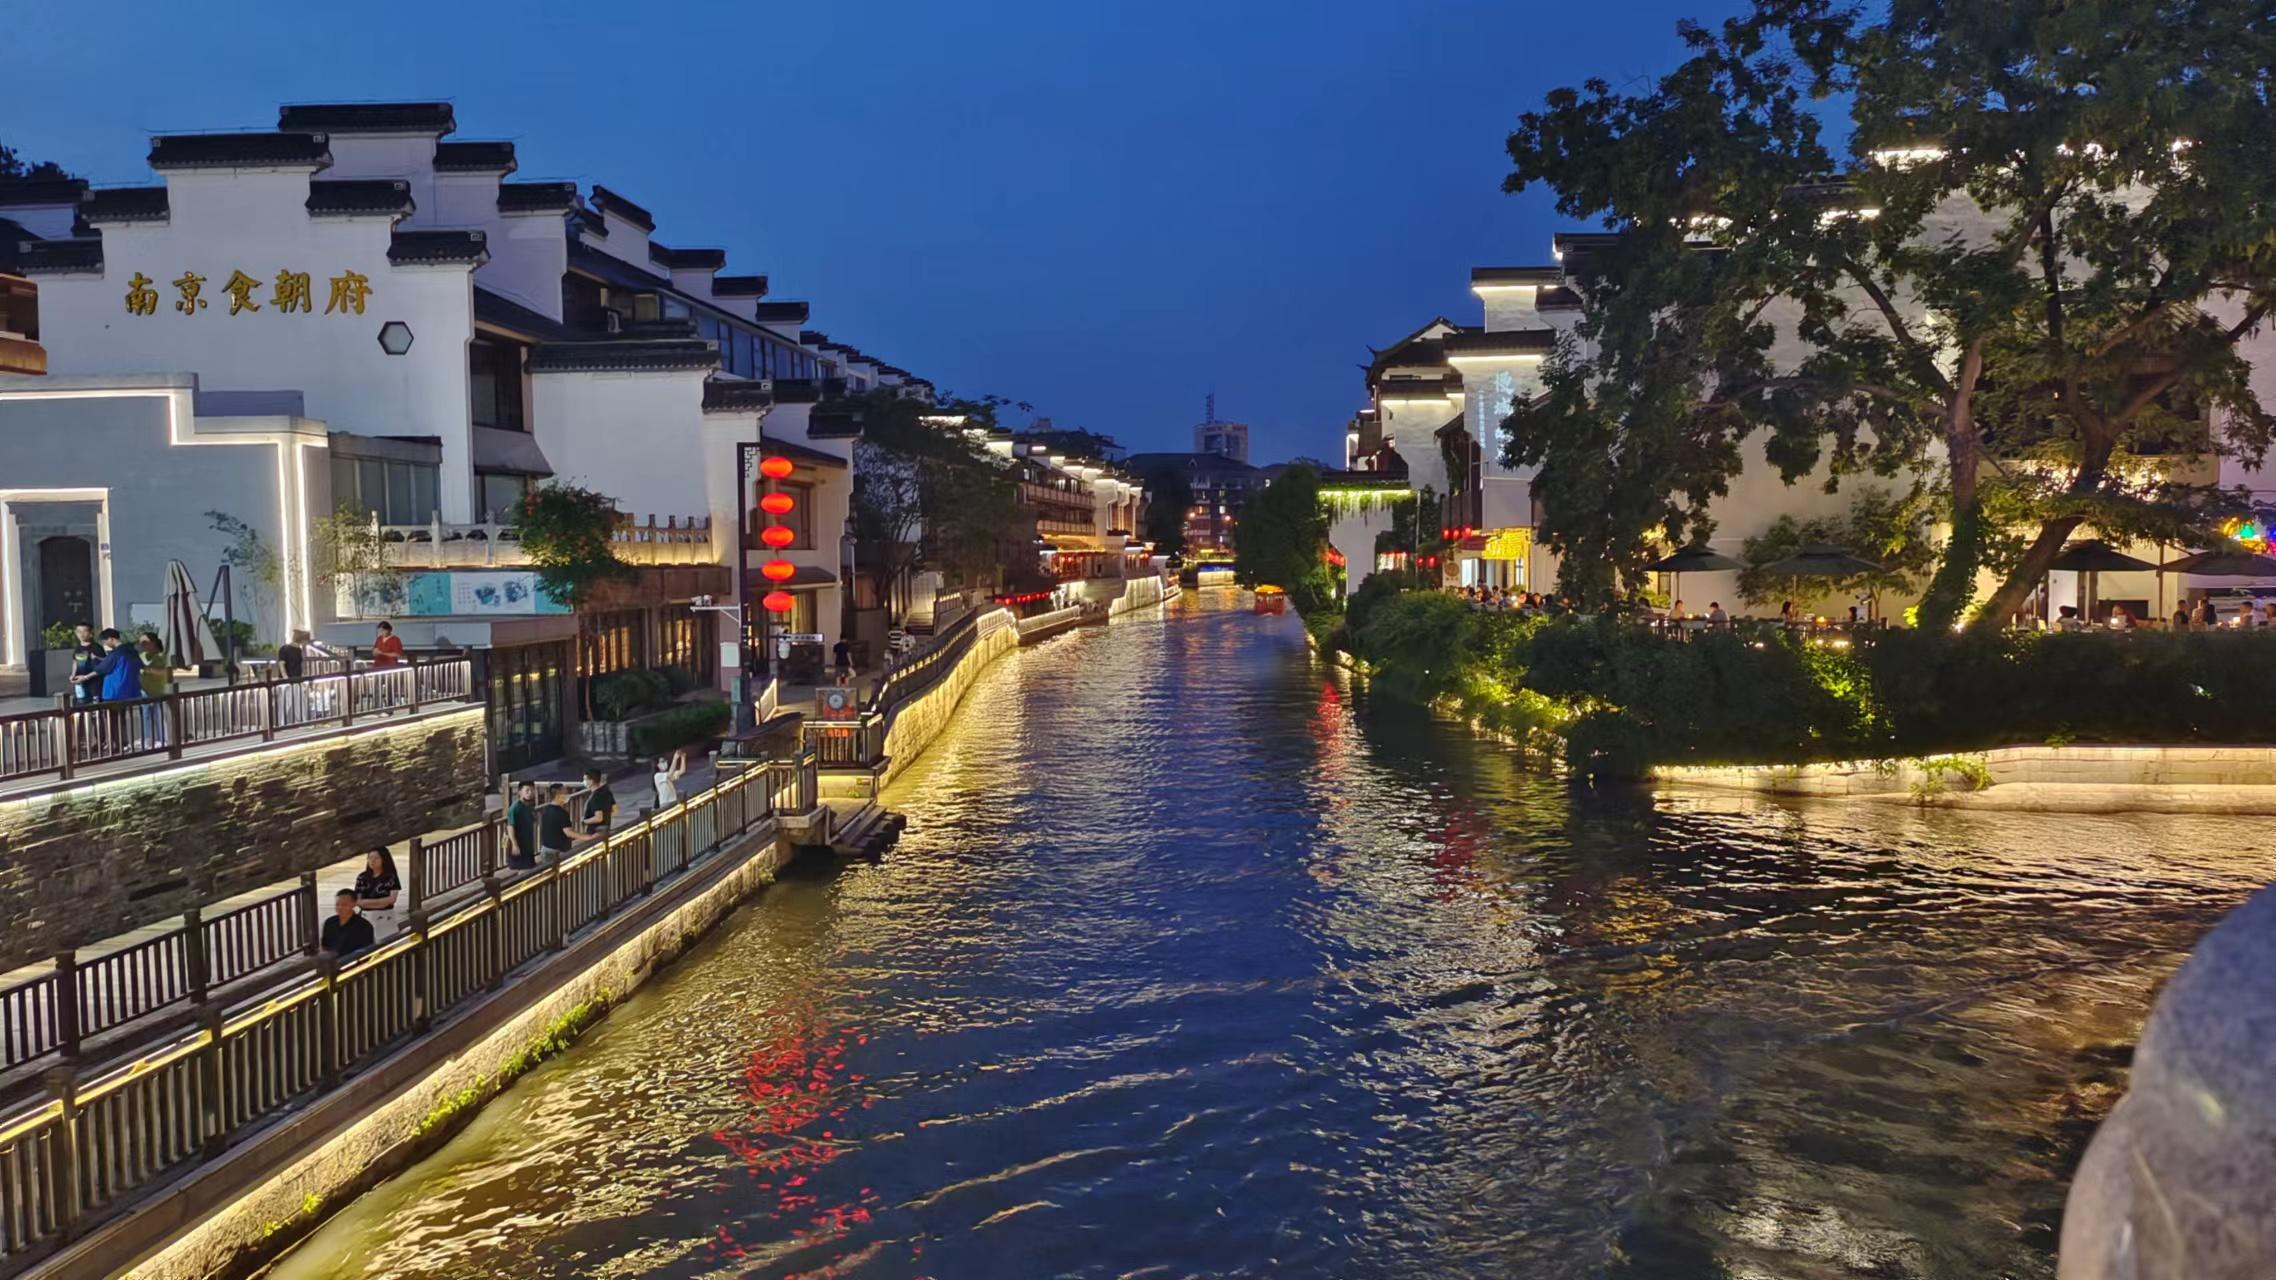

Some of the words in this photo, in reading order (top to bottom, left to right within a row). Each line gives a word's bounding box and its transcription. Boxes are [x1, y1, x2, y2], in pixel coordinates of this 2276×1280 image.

[125, 269, 373, 316] 南京食朝府
